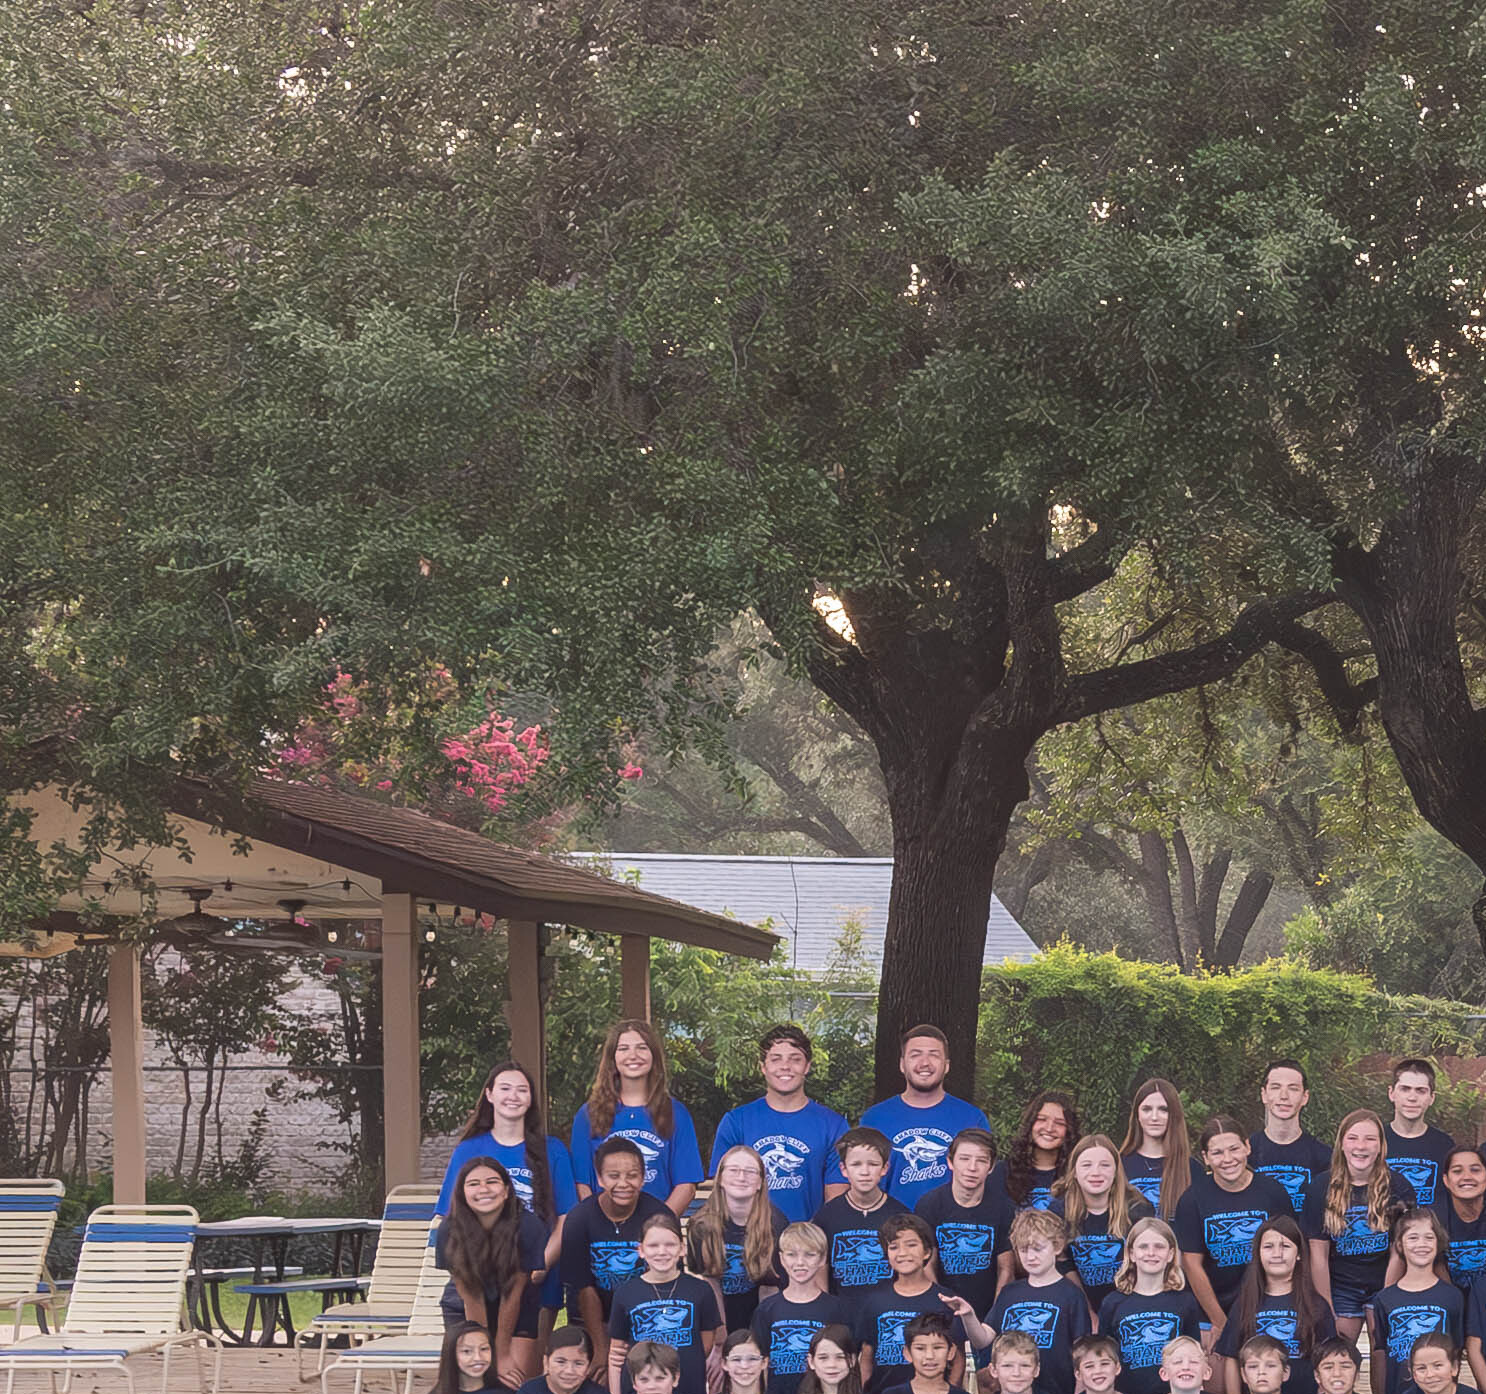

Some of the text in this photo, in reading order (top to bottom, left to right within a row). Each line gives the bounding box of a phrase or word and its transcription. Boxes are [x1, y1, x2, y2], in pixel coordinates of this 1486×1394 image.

[893, 1128, 953, 1144] SHADOW CLIFF
[900, 1161, 946, 1184] Sharks
[1125, 1312, 1161, 1320] WELCOME
